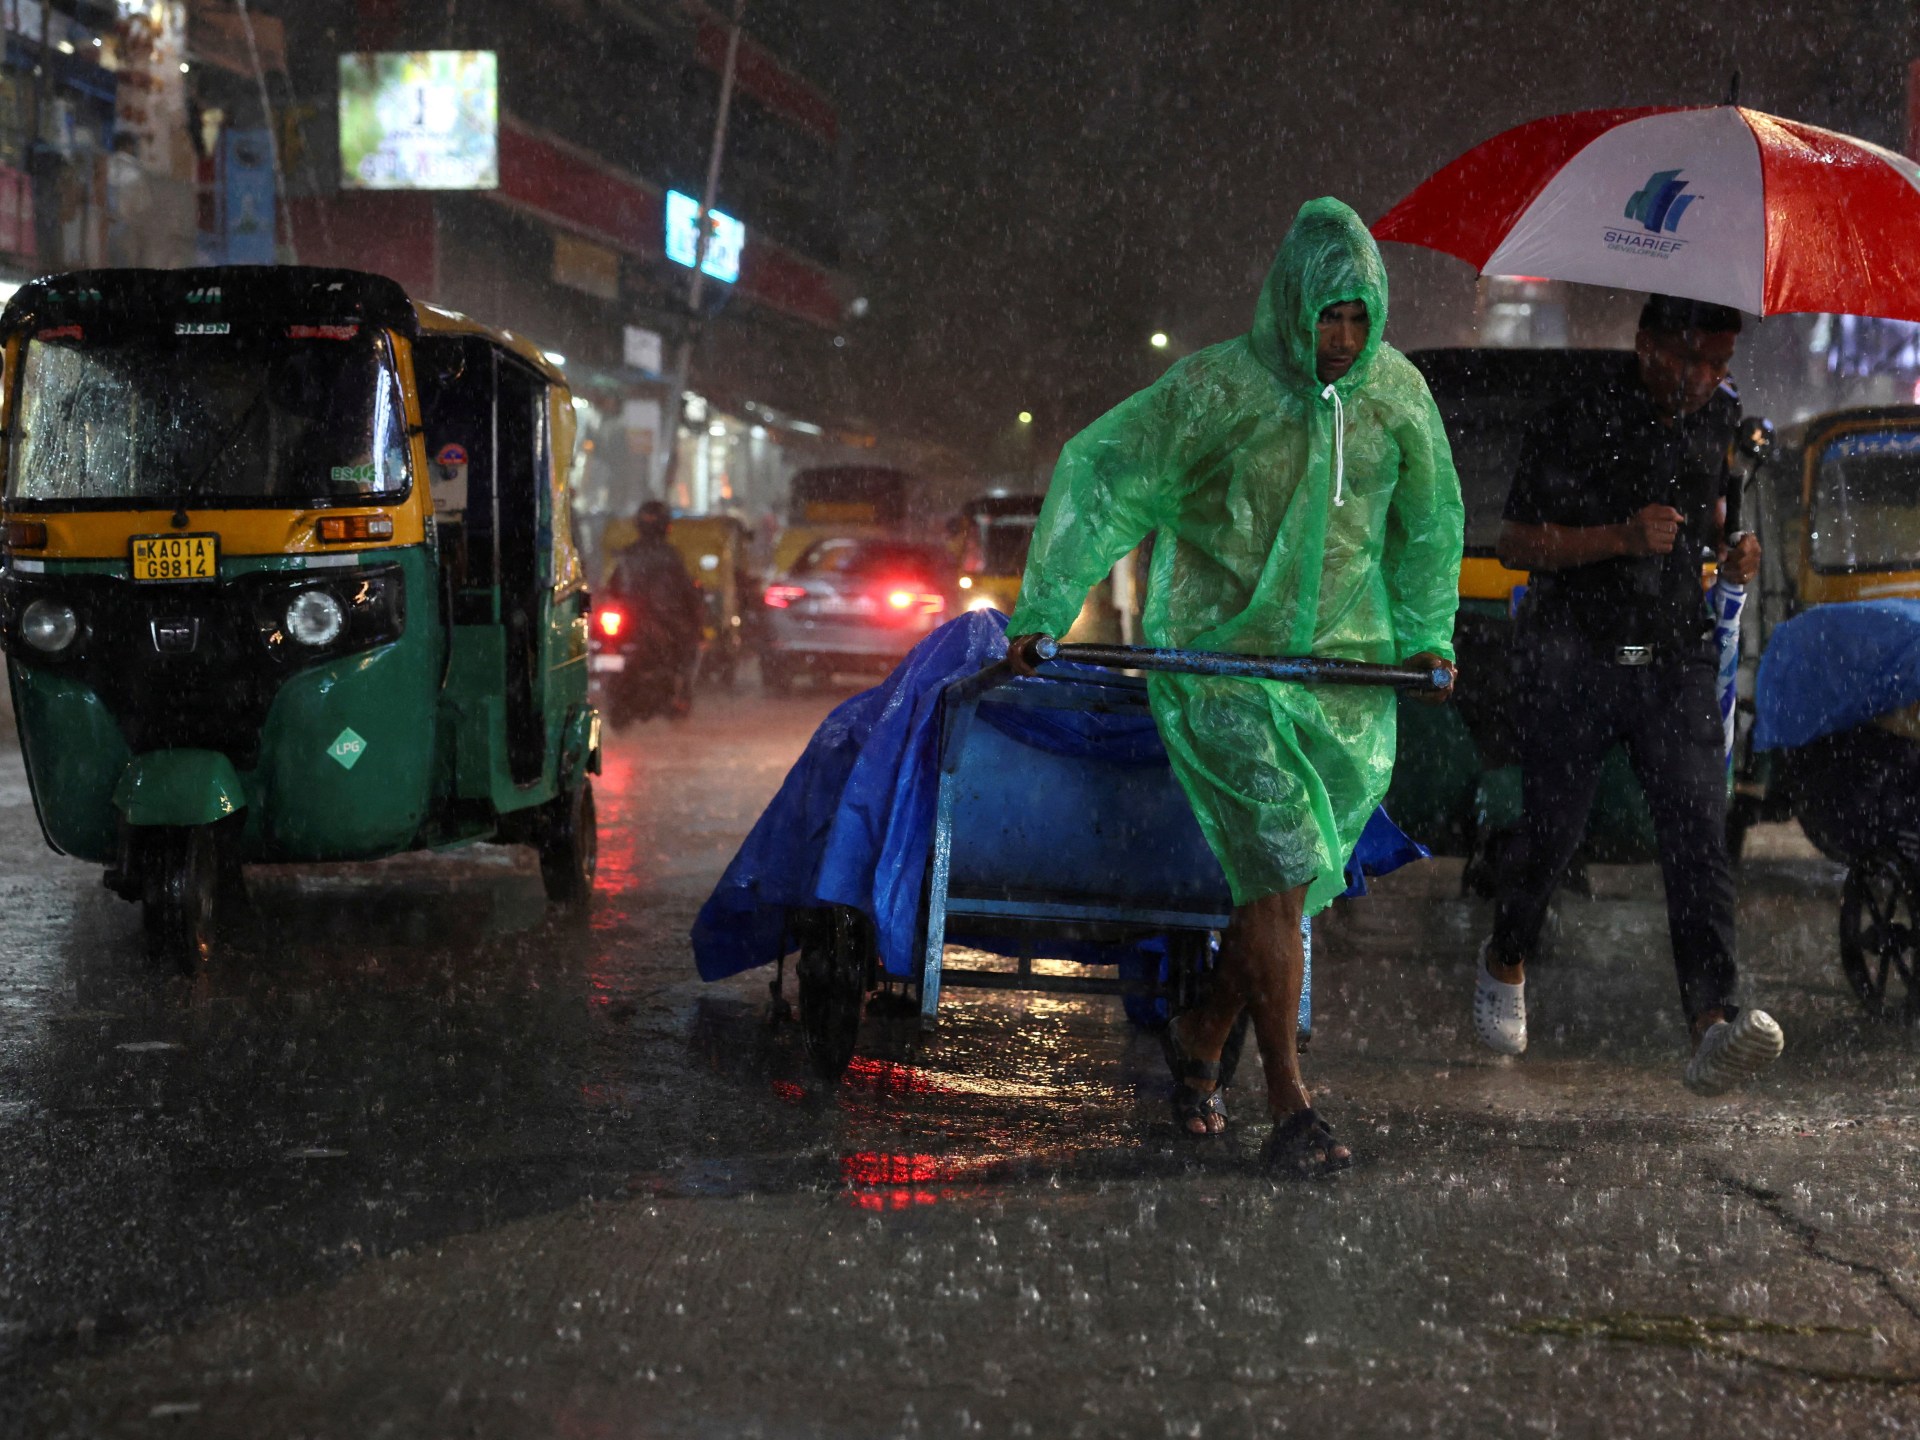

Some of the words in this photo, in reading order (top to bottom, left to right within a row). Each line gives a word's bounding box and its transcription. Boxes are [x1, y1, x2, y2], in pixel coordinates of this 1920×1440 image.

[1604, 231, 1682, 253] SHARIEF
[1607, 243, 1670, 260] DEVELOPERS
[147, 540, 205, 558] KA01A
[148, 559, 206, 577] G9814
[336, 740, 360, 755] LPG
